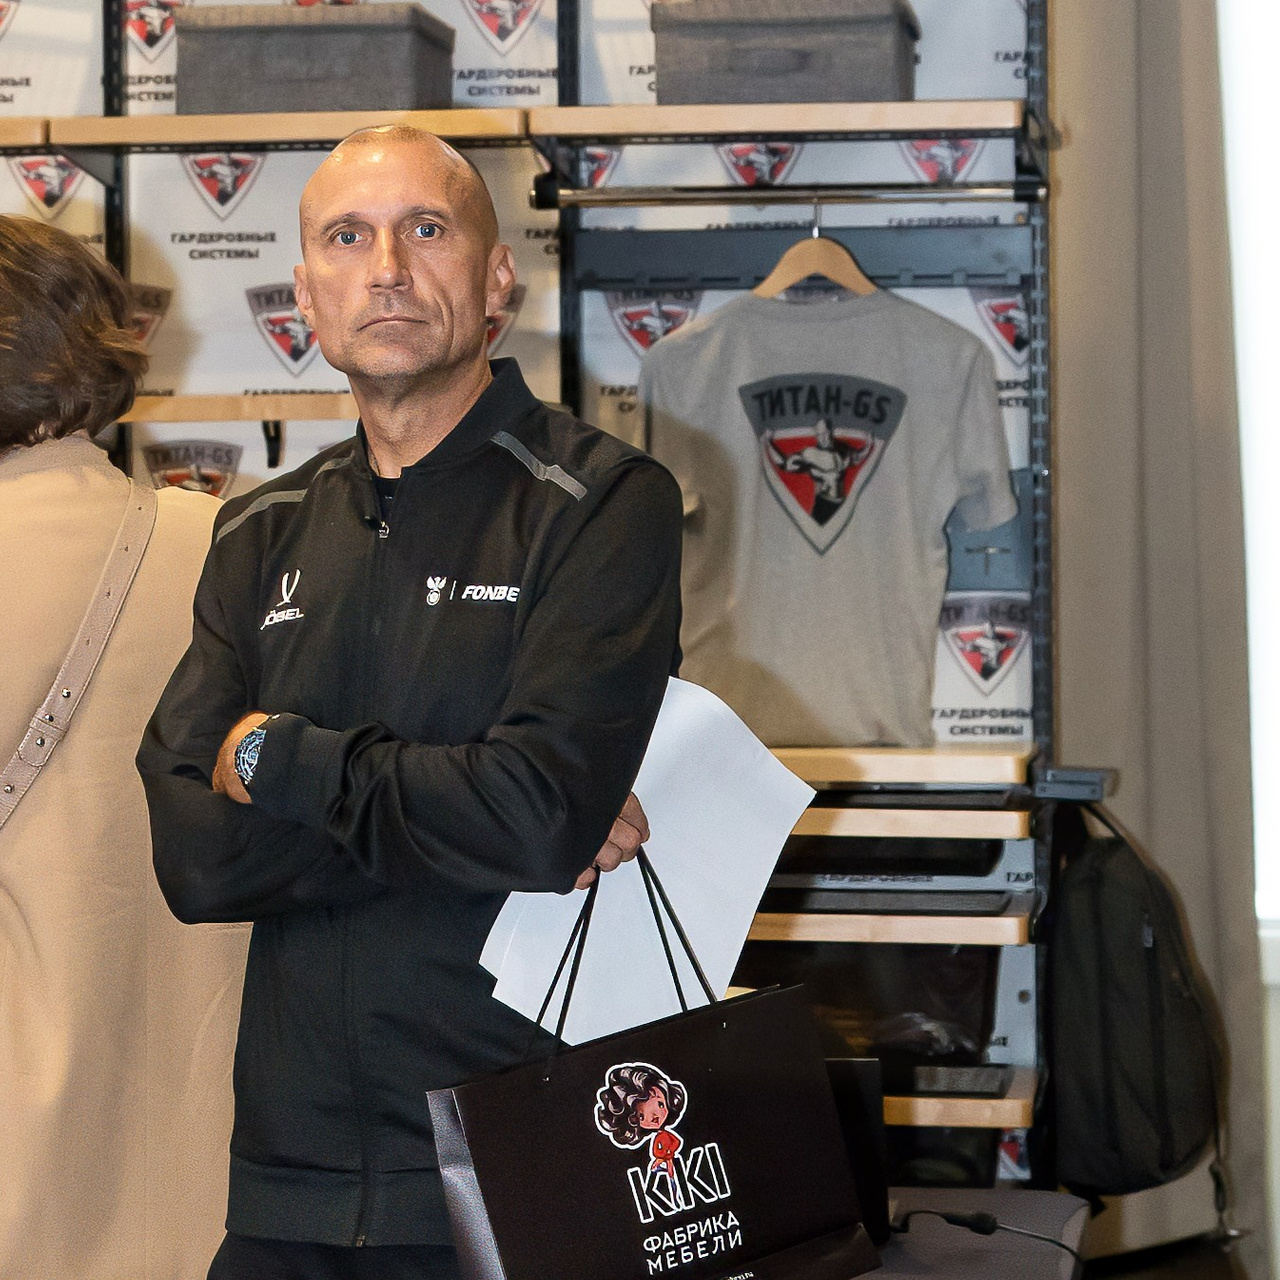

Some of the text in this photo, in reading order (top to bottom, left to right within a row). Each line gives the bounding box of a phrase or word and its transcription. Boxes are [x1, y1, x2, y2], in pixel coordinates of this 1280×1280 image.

[461, 585, 520, 602] FONBE
[643, 1210, 740, 1253] ФАБРИКА
[646, 1228, 743, 1276] МЕБЕЛИ
